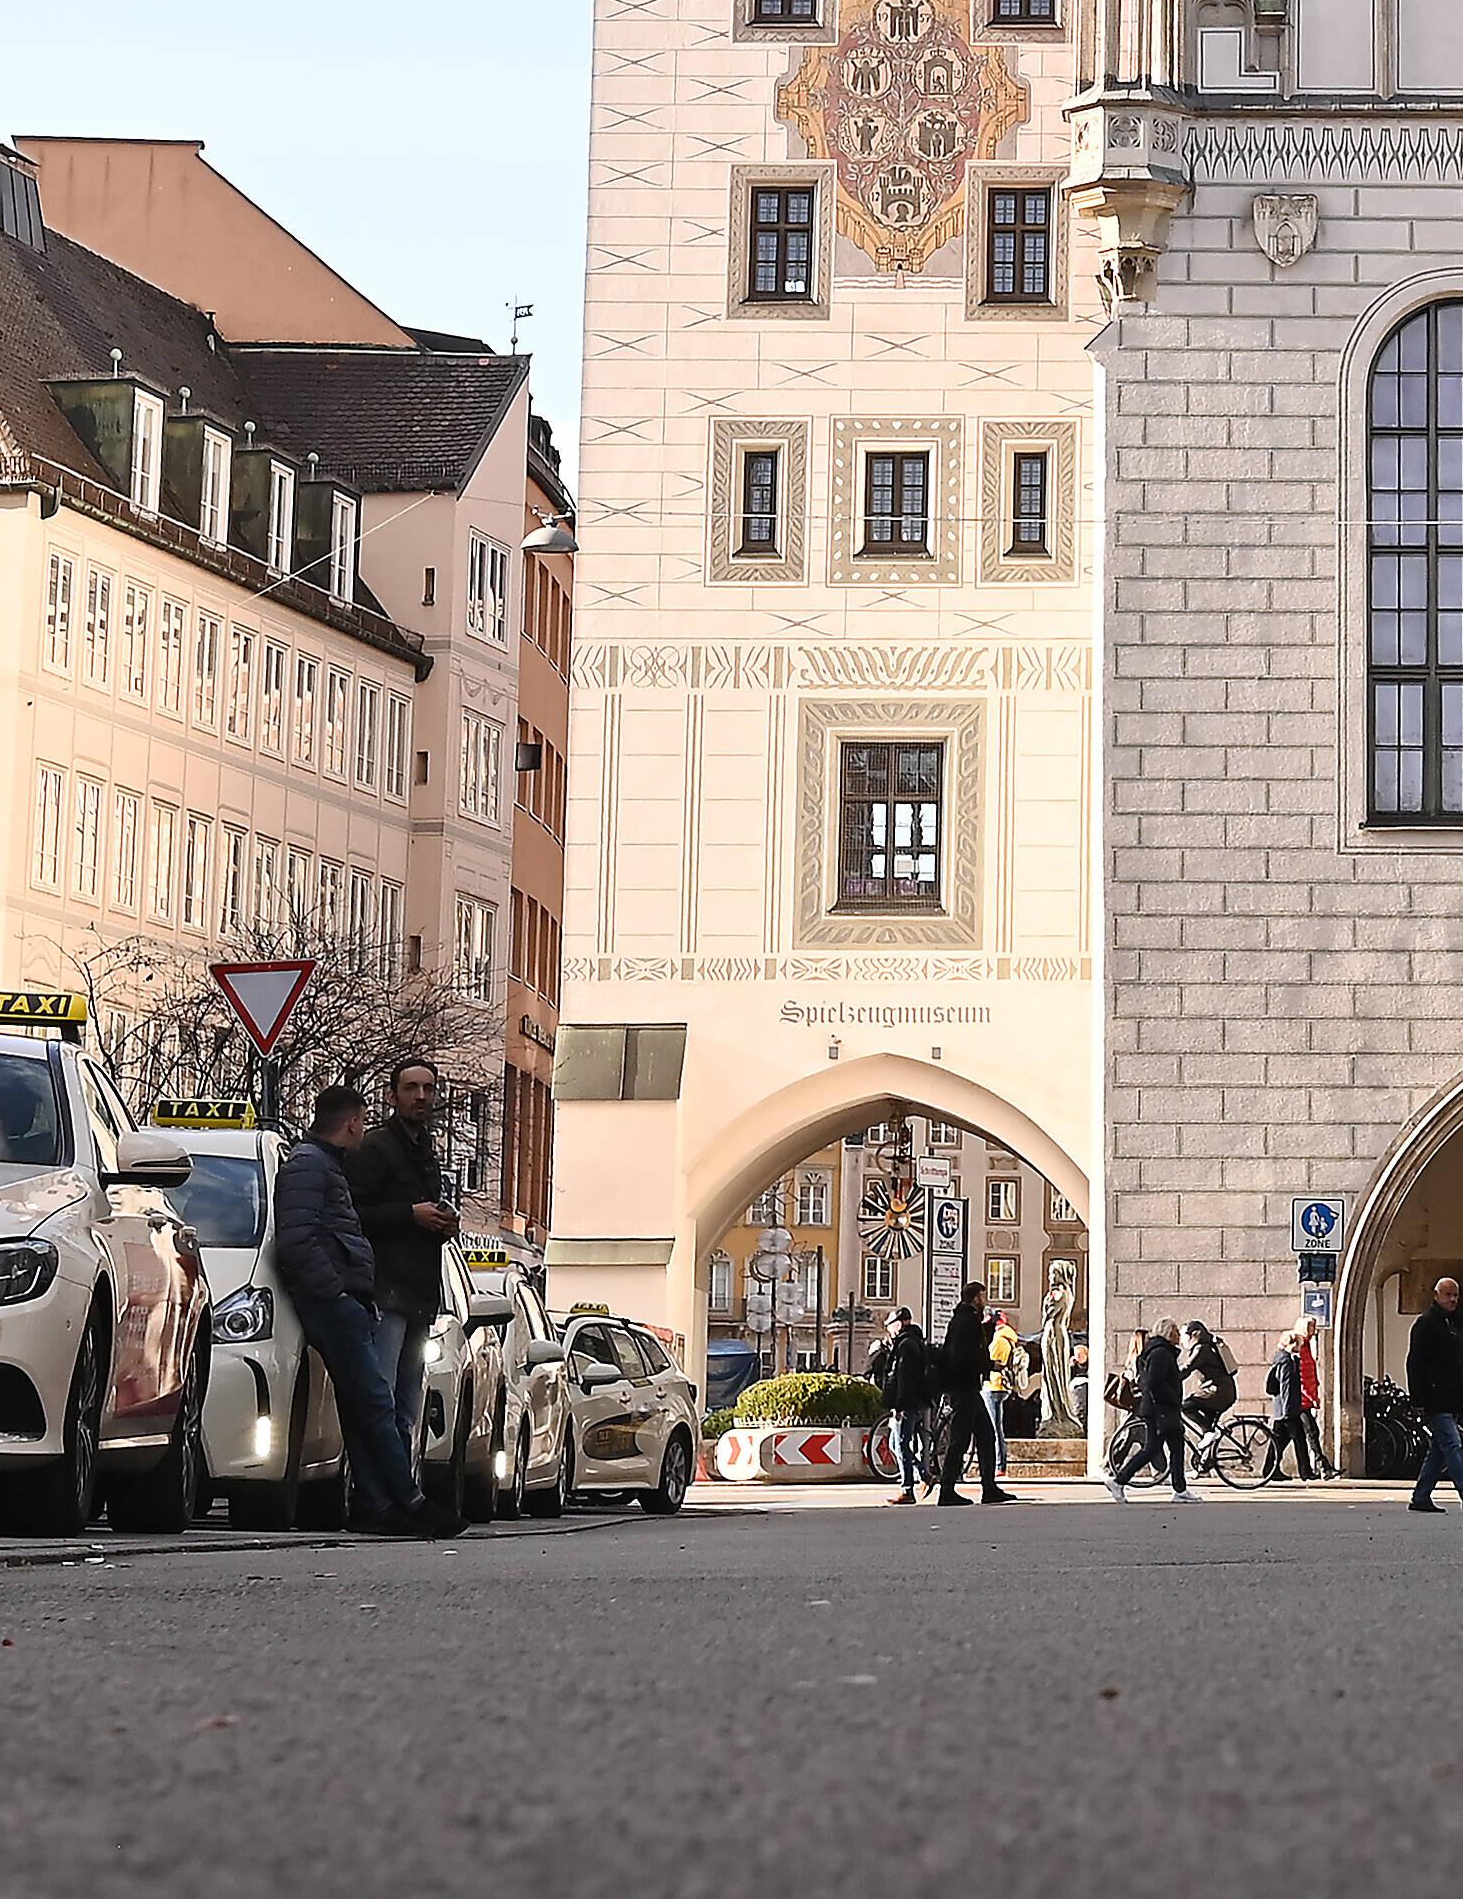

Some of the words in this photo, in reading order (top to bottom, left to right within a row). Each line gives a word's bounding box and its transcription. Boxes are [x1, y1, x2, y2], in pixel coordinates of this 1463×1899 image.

[779, 999, 991, 1028] Spielzeugmuseum
[169, 1101, 235, 1118] TAXI
[1304, 1238, 1331, 1249] ZONE
[462, 1251, 499, 1262] AXI
